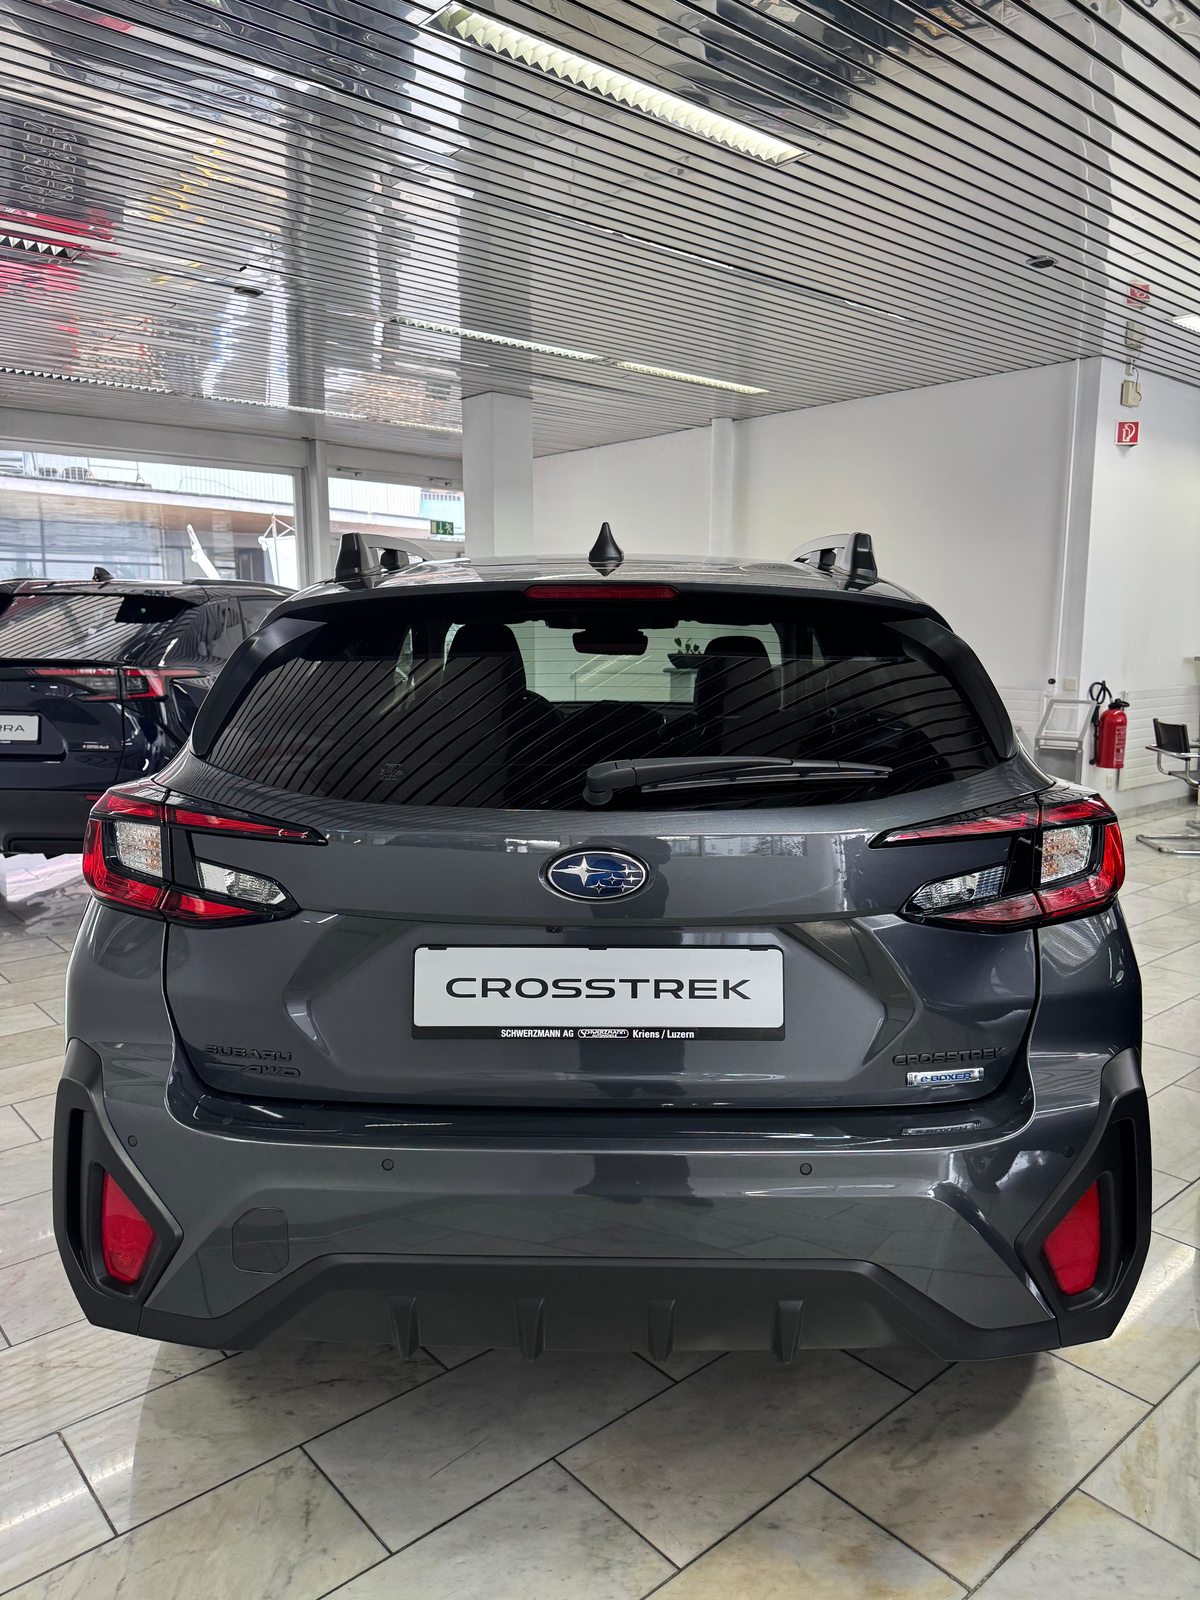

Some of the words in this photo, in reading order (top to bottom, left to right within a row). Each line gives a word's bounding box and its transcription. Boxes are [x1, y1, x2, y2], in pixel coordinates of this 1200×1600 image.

[446, 977, 752, 1000] CROSSTREK
[500, 1029, 561, 1038] SCHWERZMANN
[562, 1029, 574, 1038] AG
[632, 1029, 660, 1039] Kriens
[667, 1030, 695, 1039] Luzern
[204, 1045, 292, 1061] SUBARU
[892, 1047, 1006, 1067] CROSSTREK
[240, 1064, 301, 1079] AWD
[920, 1072, 972, 1083] e-BOXER
